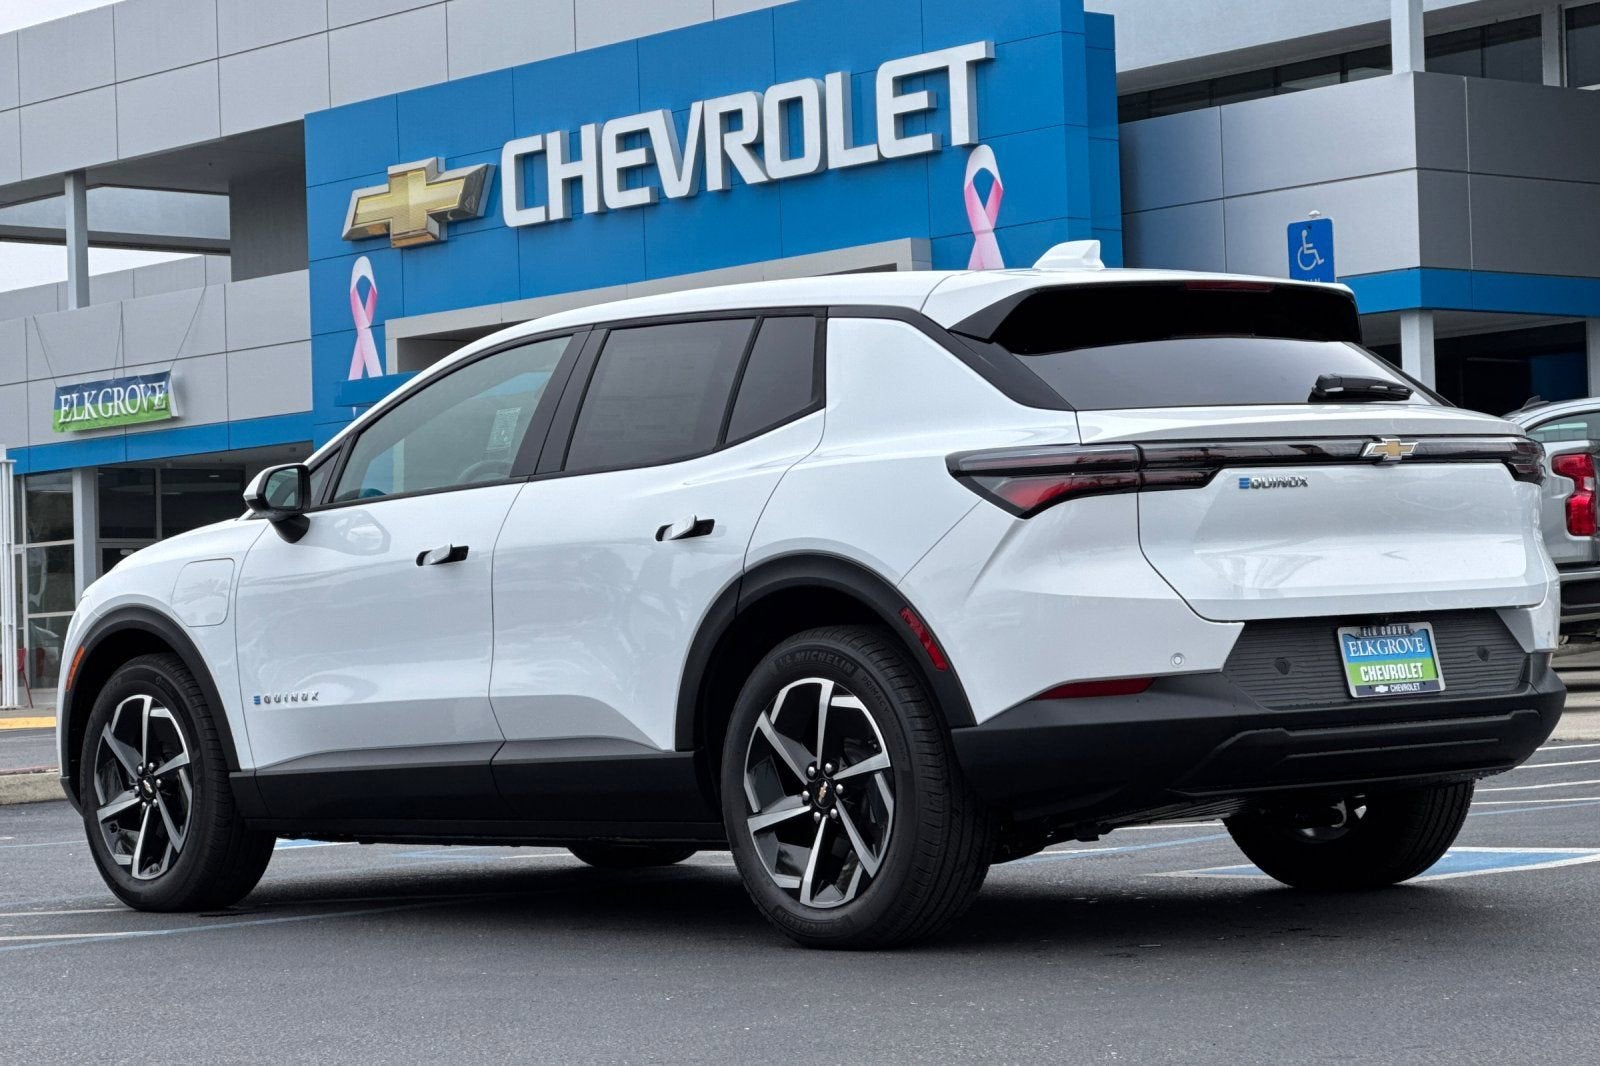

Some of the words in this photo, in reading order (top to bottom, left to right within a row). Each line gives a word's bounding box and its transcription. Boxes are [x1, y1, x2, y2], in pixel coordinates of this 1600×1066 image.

[501, 40, 995, 227] CHEVROLET
[1238, 476, 1308, 490] EQUINOX
[794, 650, 855, 674] MICHELIN
[1360, 663, 1423, 682] CHEVROLET
[1390, 683, 1421, 692] CHEVROLET
[253, 691, 319, 705] EQUINOX
